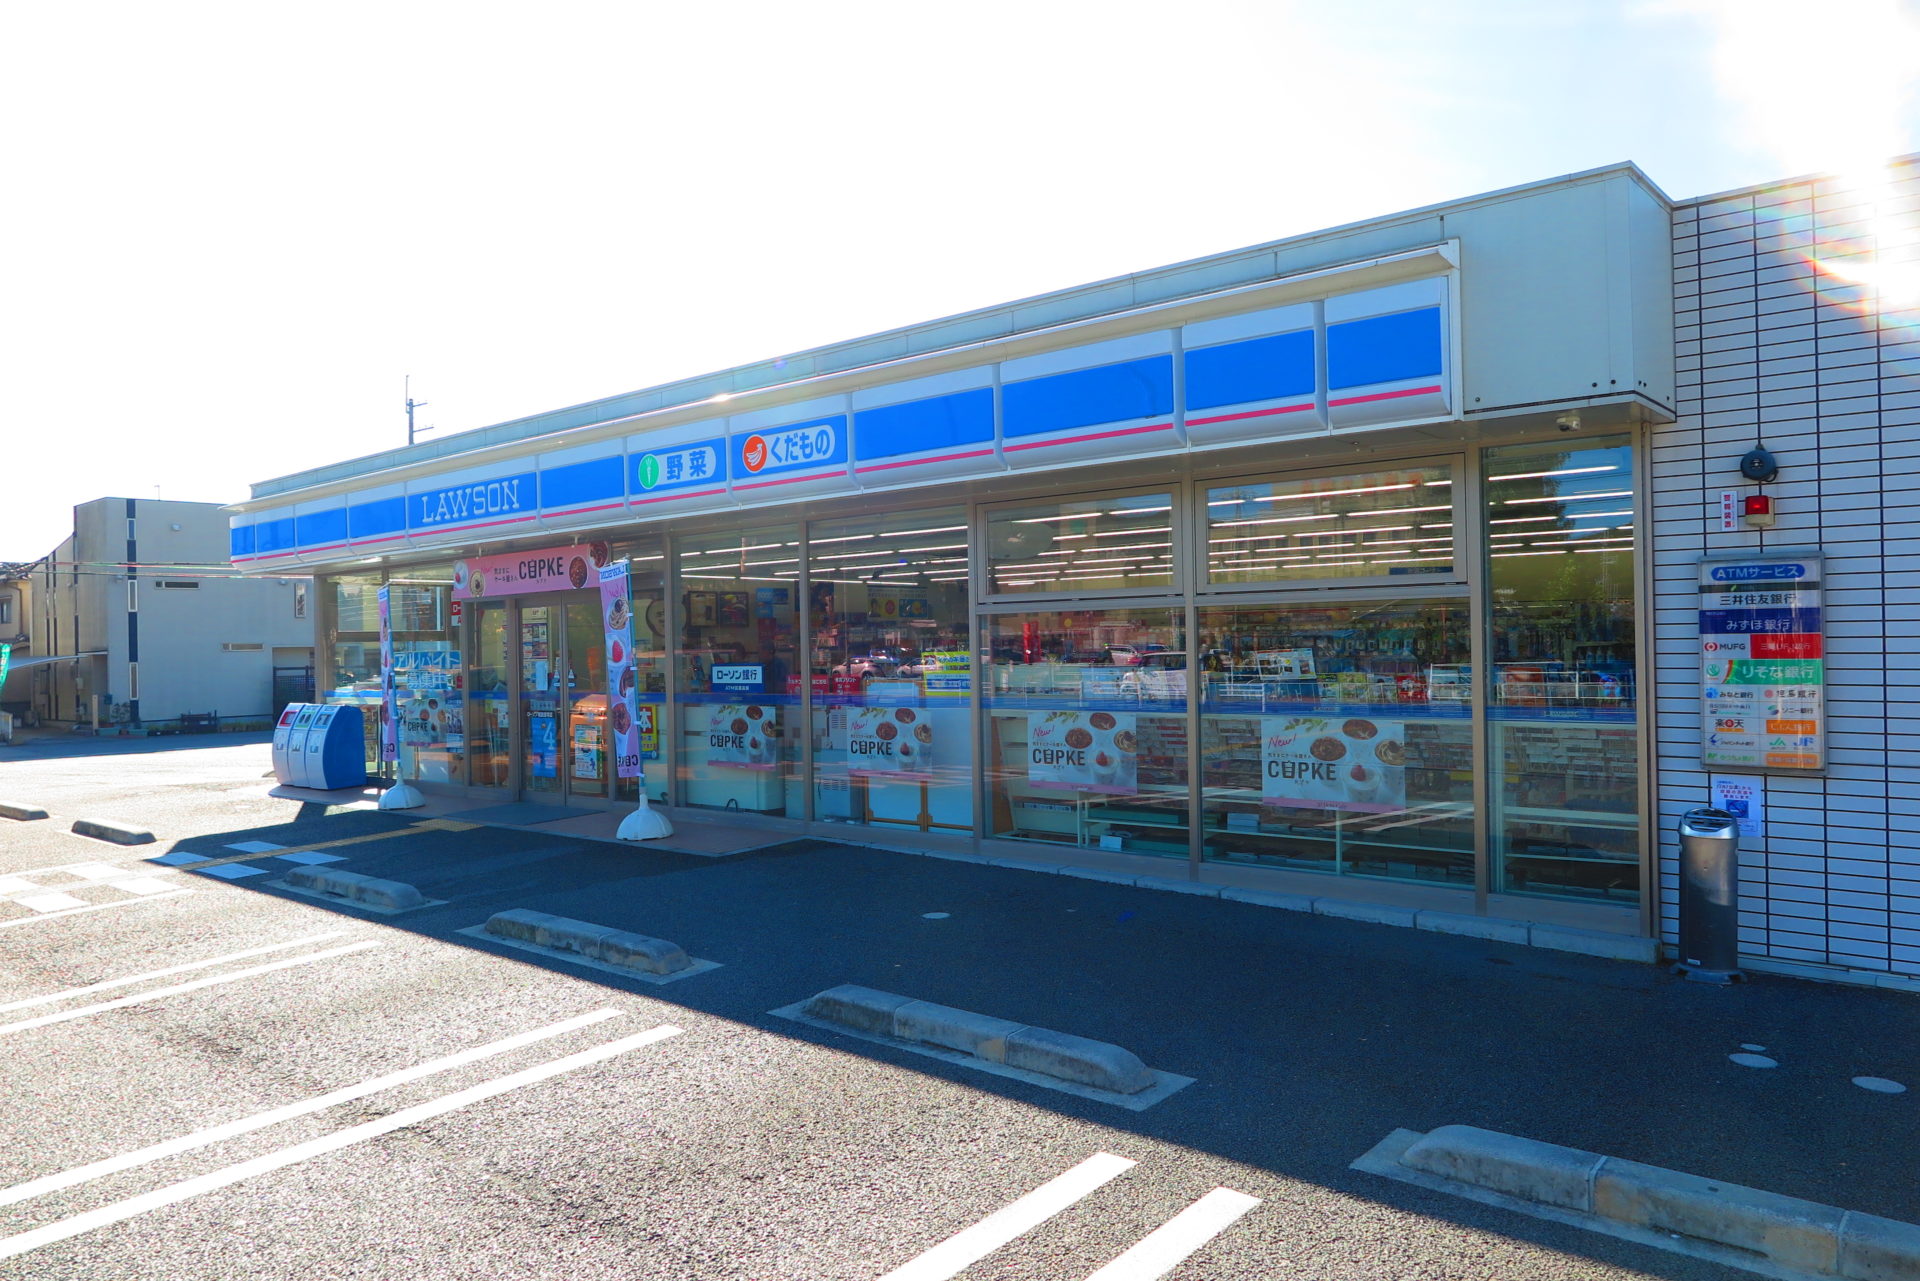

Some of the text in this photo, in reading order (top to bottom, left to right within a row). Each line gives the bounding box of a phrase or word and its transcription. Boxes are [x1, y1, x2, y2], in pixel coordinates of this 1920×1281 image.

[771, 429, 830, 463] くだもの
[666, 450, 706, 481] 野菜
[421, 479, 519, 523] LAWSON
[519, 556, 564, 580] CUPKE
[1716, 565, 1799, 579] ATMサービス
[1720, 593, 1797, 606] 三井住友銀行
[1726, 619, 1790, 632] みずほ銀行
[1720, 643, 1746, 651] MUFG
[394, 652, 460, 670] アルバイト
[716, 669, 757, 681] ローソン銀行
[1742, 665, 1814, 679] りそな銀行
[1720, 691, 1754, 699] みなと銀行
[1782, 707, 1814, 715] ソニー銀行
[1032, 724, 1055, 739] New!
[710, 734, 744, 749] CUPKE
[850, 740, 893, 756] CUPKE
[1267, 733, 1297, 749] New!
[1032, 749, 1086, 766] CUPKE
[1267, 760, 1337, 780] CUPKE
